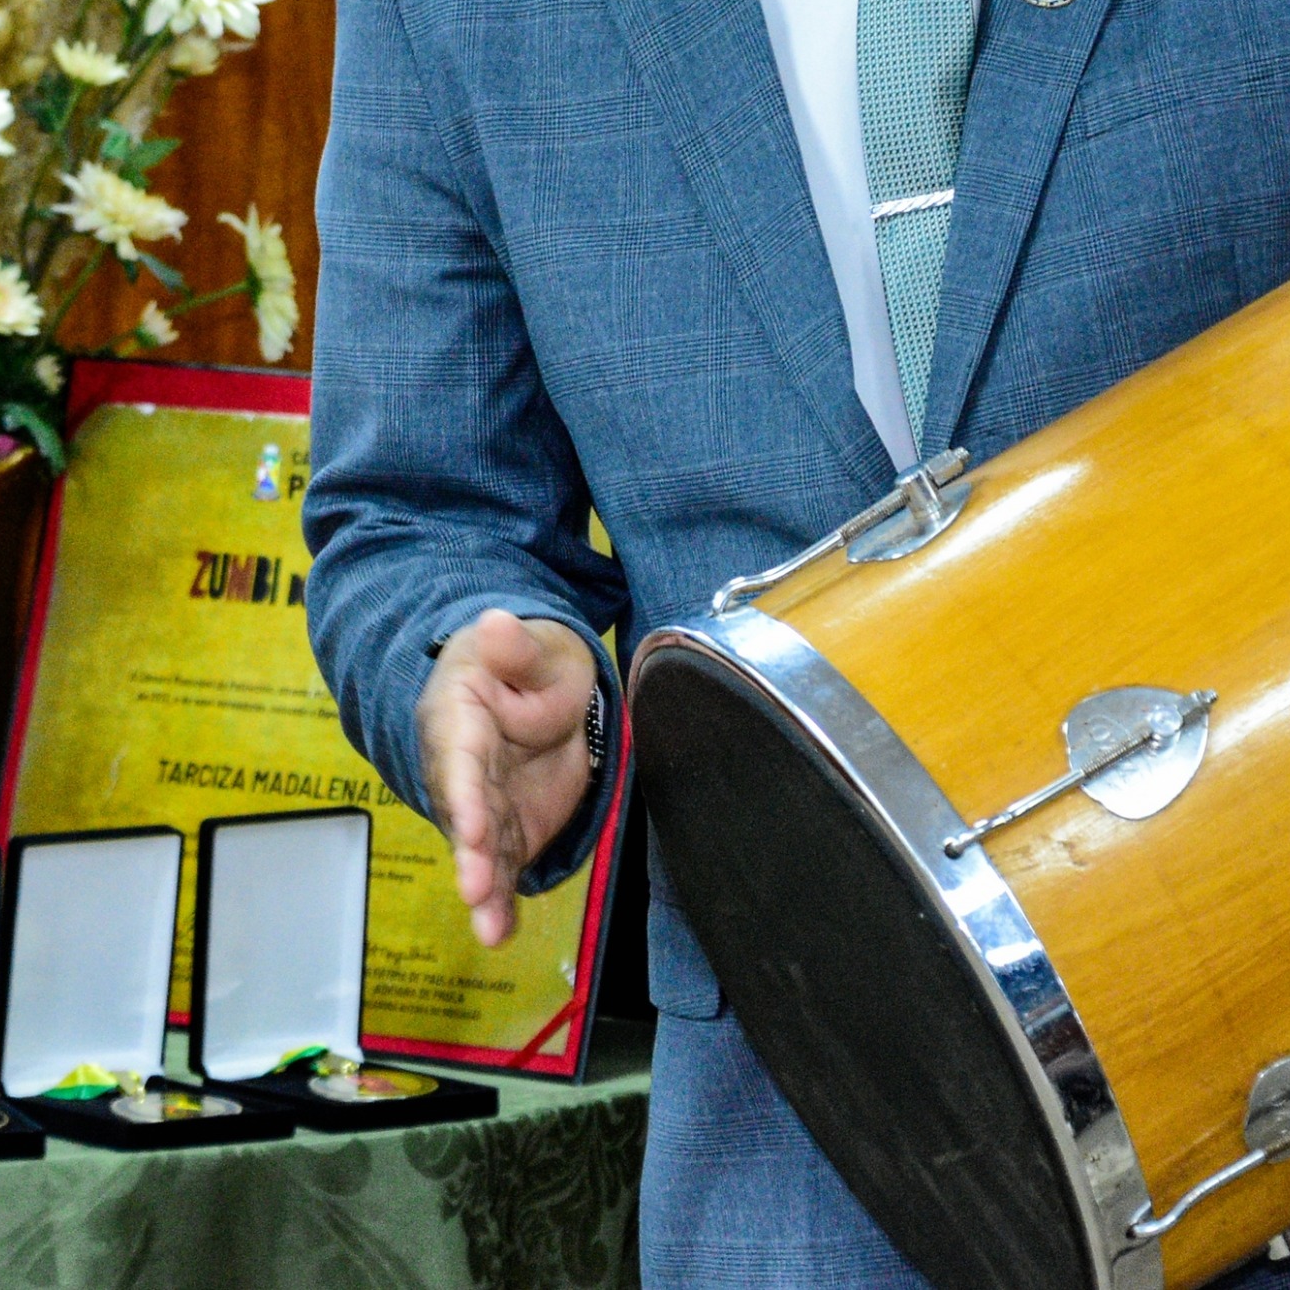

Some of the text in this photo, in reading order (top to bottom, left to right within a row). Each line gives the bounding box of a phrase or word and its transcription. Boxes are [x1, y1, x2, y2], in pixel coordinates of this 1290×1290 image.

[190, 550, 282, 606] ZUMBI
[159, 760, 246, 791] TARCIZA
[251, 770, 372, 804] MADALENA
